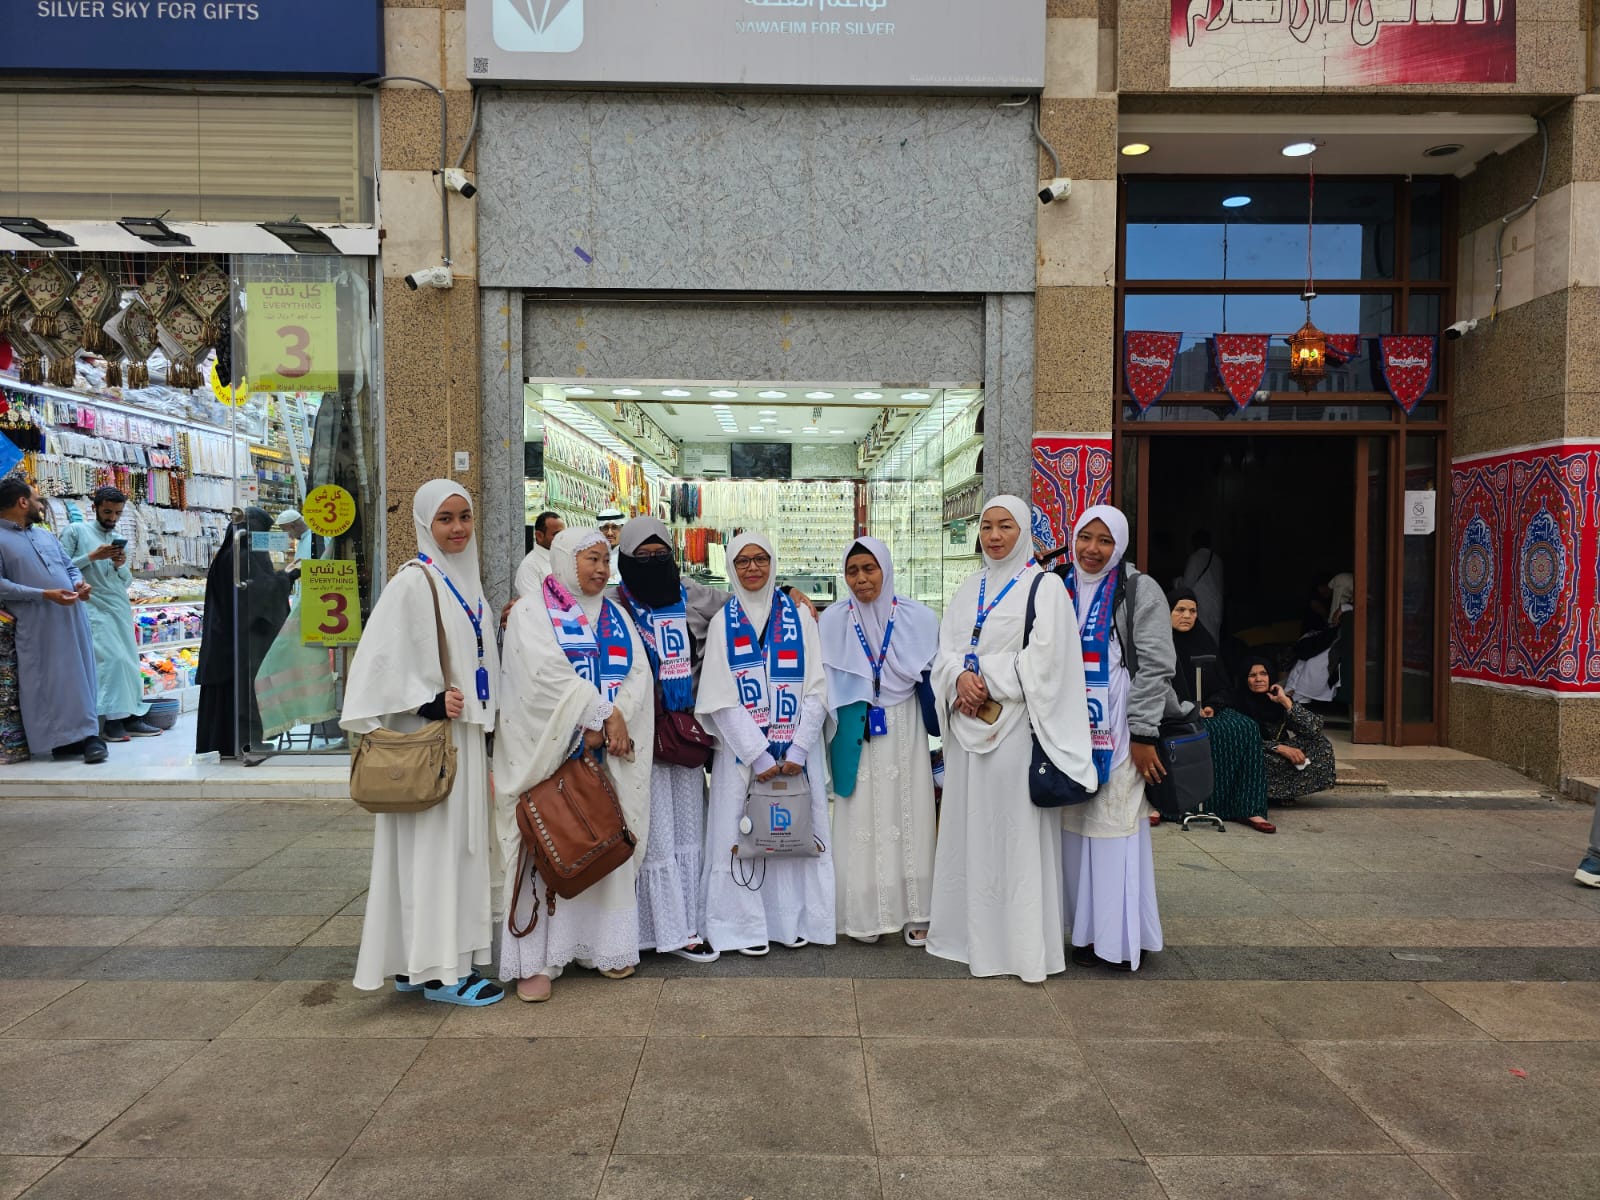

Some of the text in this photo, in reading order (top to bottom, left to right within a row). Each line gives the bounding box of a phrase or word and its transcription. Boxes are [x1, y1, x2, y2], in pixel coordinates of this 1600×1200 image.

[37, 0, 259, 20] SILVER SKY FOR GIFTS
[811, 22, 841, 34] FOR
[845, 22, 895, 35] SILVER
[299, 284, 321, 299] كل
[263, 302, 321, 310] EVERYTHING
[276, 325, 312, 378] 3
[331, 490, 342, 501] كل
[323, 502, 337, 523] 3
[309, 517, 351, 535] EVERYTHING
[337, 565, 354, 576] كل
[318, 592, 350, 634] 3
